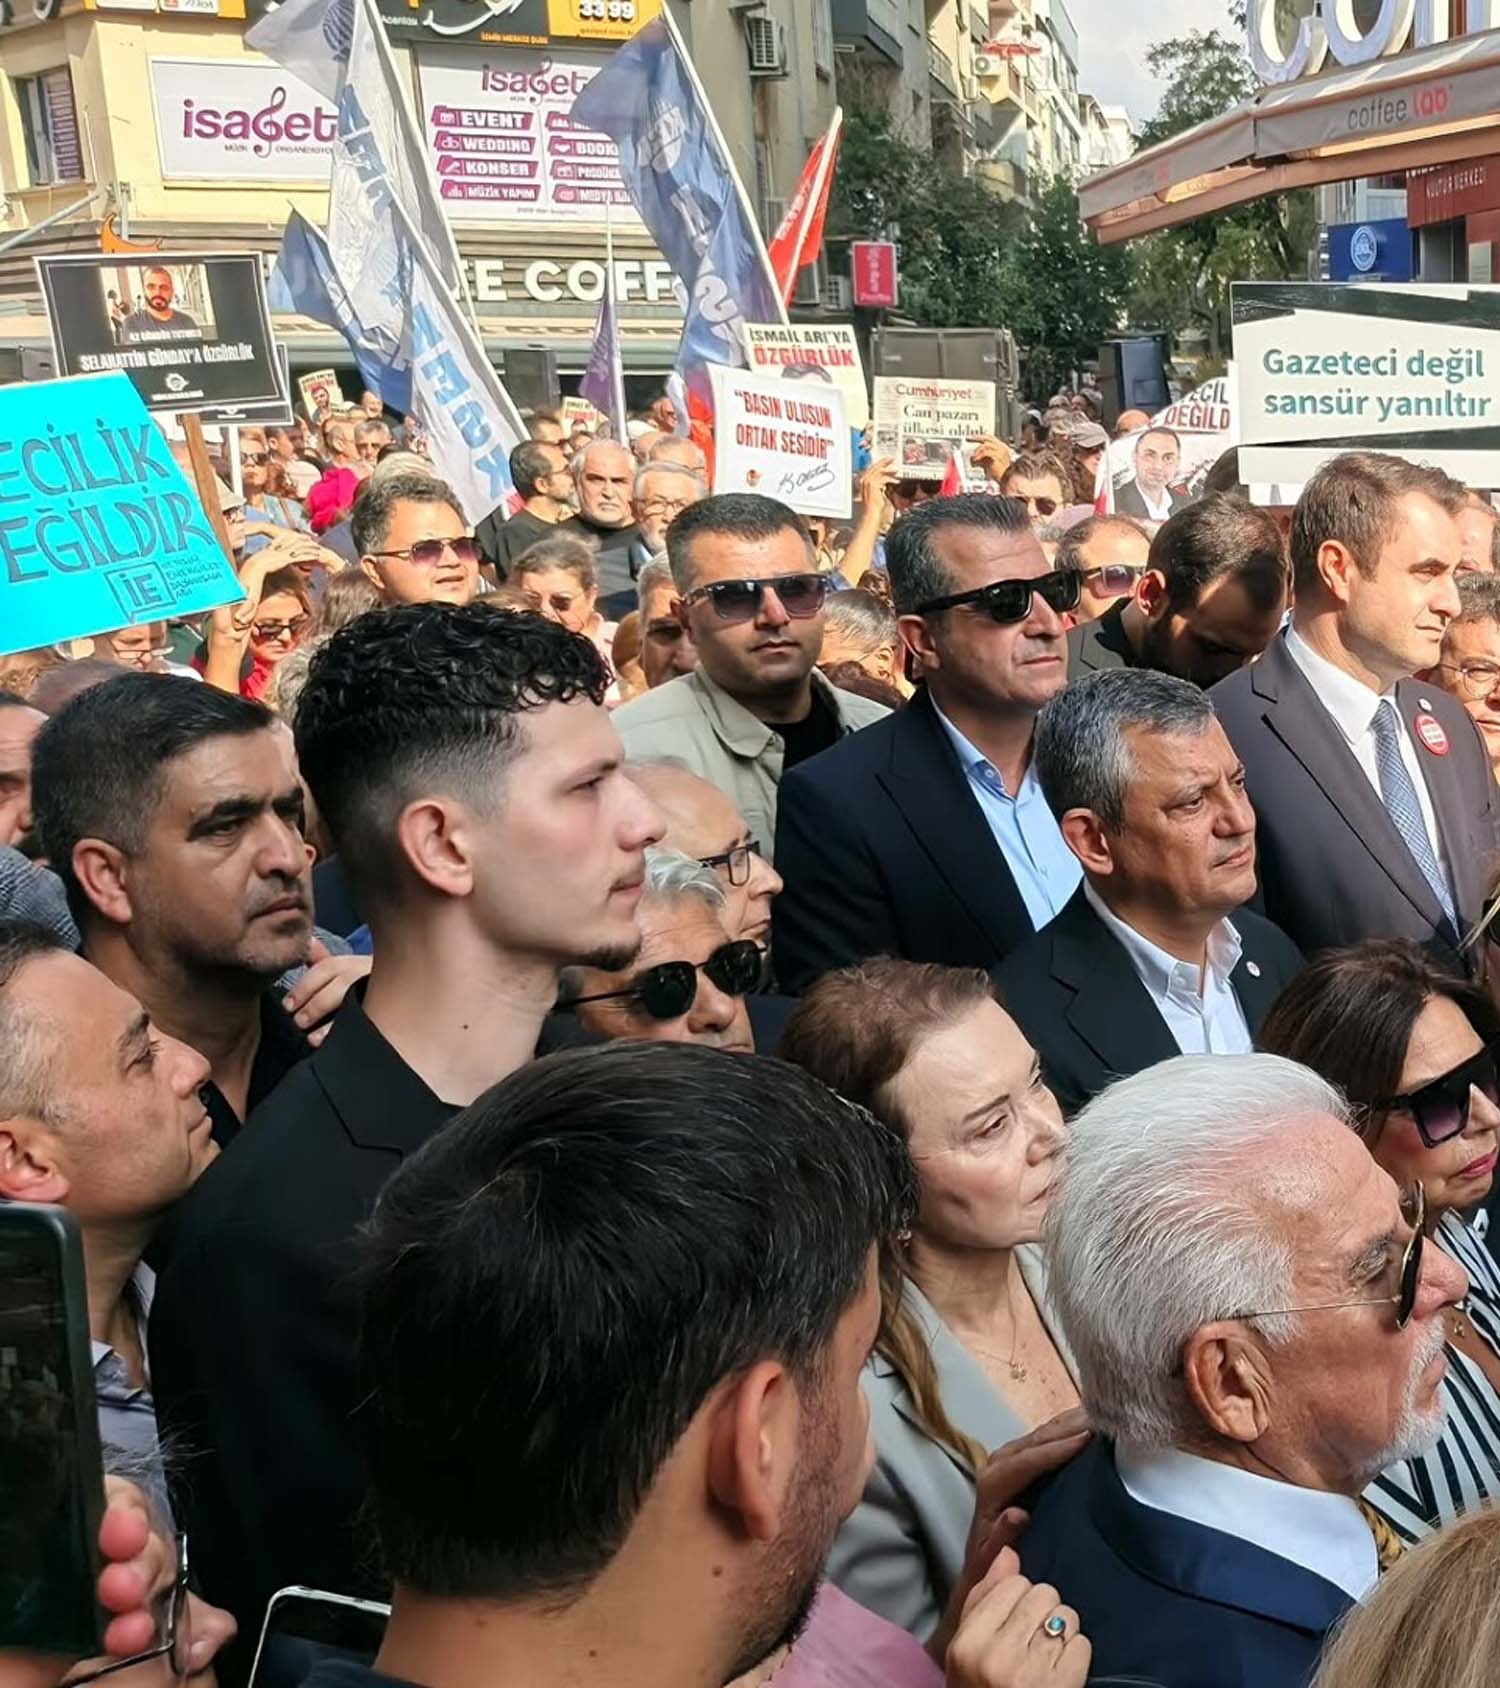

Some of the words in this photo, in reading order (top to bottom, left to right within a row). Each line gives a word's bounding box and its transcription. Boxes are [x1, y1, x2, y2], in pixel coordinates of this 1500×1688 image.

[461, 111, 525, 129] EVENT
[1348, 95, 1408, 132] coffee
[466, 161, 530, 176] KONSER
[753, 345, 856, 368] ÖZGÜRLÜK
[1262, 347, 1397, 378] Gazeteci
[1406, 348, 1486, 383] değil
[895, 383, 973, 401] Cumhuriyet
[1263, 388, 1370, 417] sansür
[1371, 388, 1492, 423] yanıltır
[735, 423, 778, 452] ORTAK
